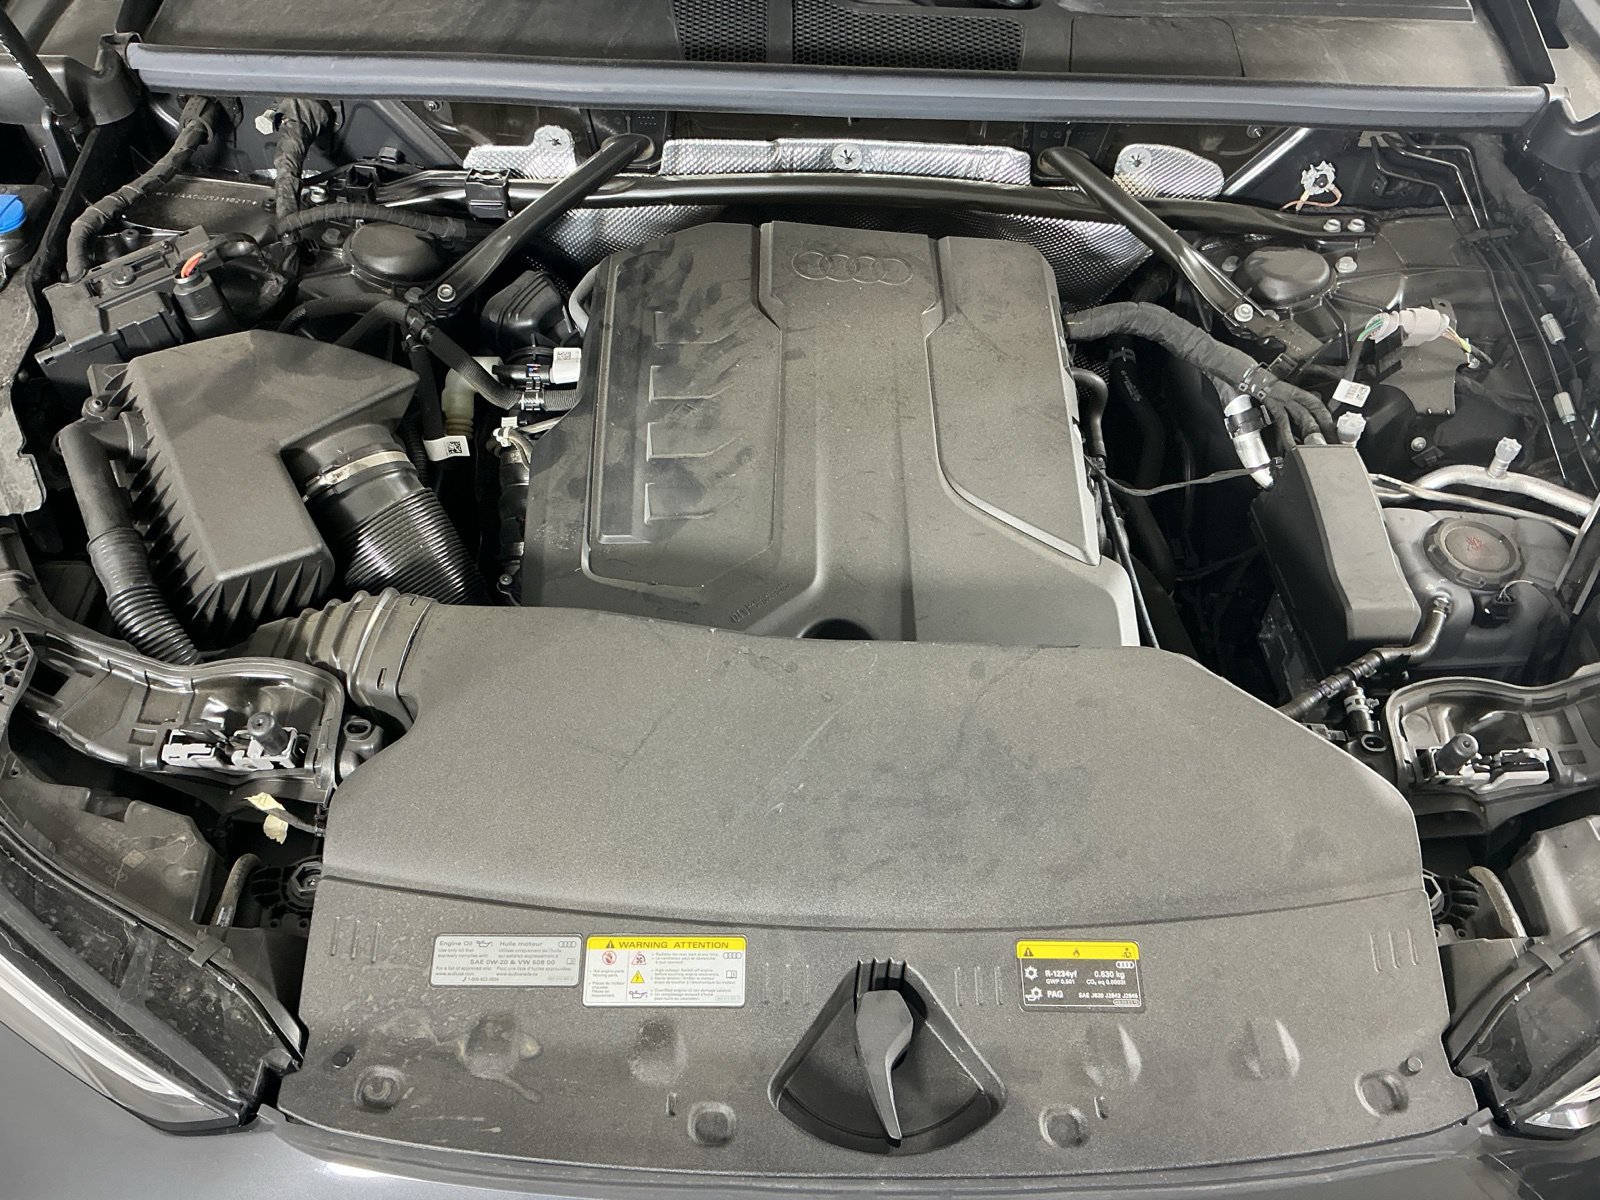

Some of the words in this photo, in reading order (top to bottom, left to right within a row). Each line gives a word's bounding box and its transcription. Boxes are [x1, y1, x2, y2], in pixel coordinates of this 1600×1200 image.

[1045, 970, 1077, 978] R-1234yf
[1116, 970, 1125, 979] kg
[1047, 990, 1063, 998] PAG
